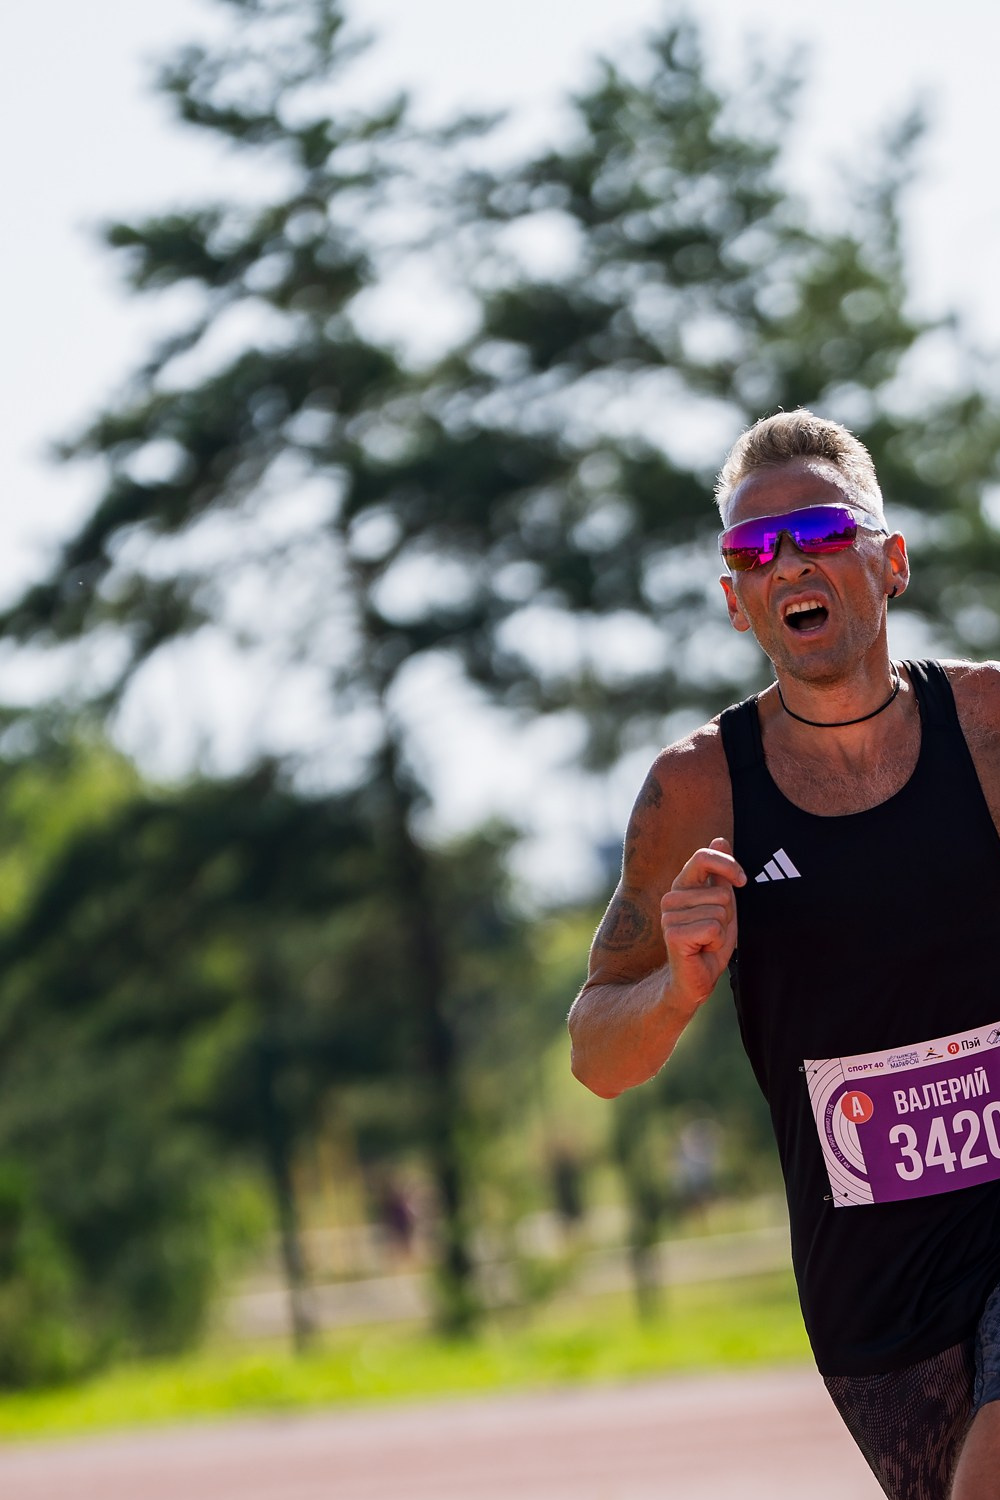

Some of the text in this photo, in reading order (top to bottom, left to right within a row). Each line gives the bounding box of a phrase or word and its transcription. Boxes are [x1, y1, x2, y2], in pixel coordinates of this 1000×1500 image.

[961, 1037, 981, 1050] Пэй
[847, 1063, 873, 1073] СПОРТ
[874, 1061, 884, 1069] 40
[890, 1058, 920, 1069] МАРАФОН
[893, 1067, 990, 1115] ВАЛЕРИЙ
